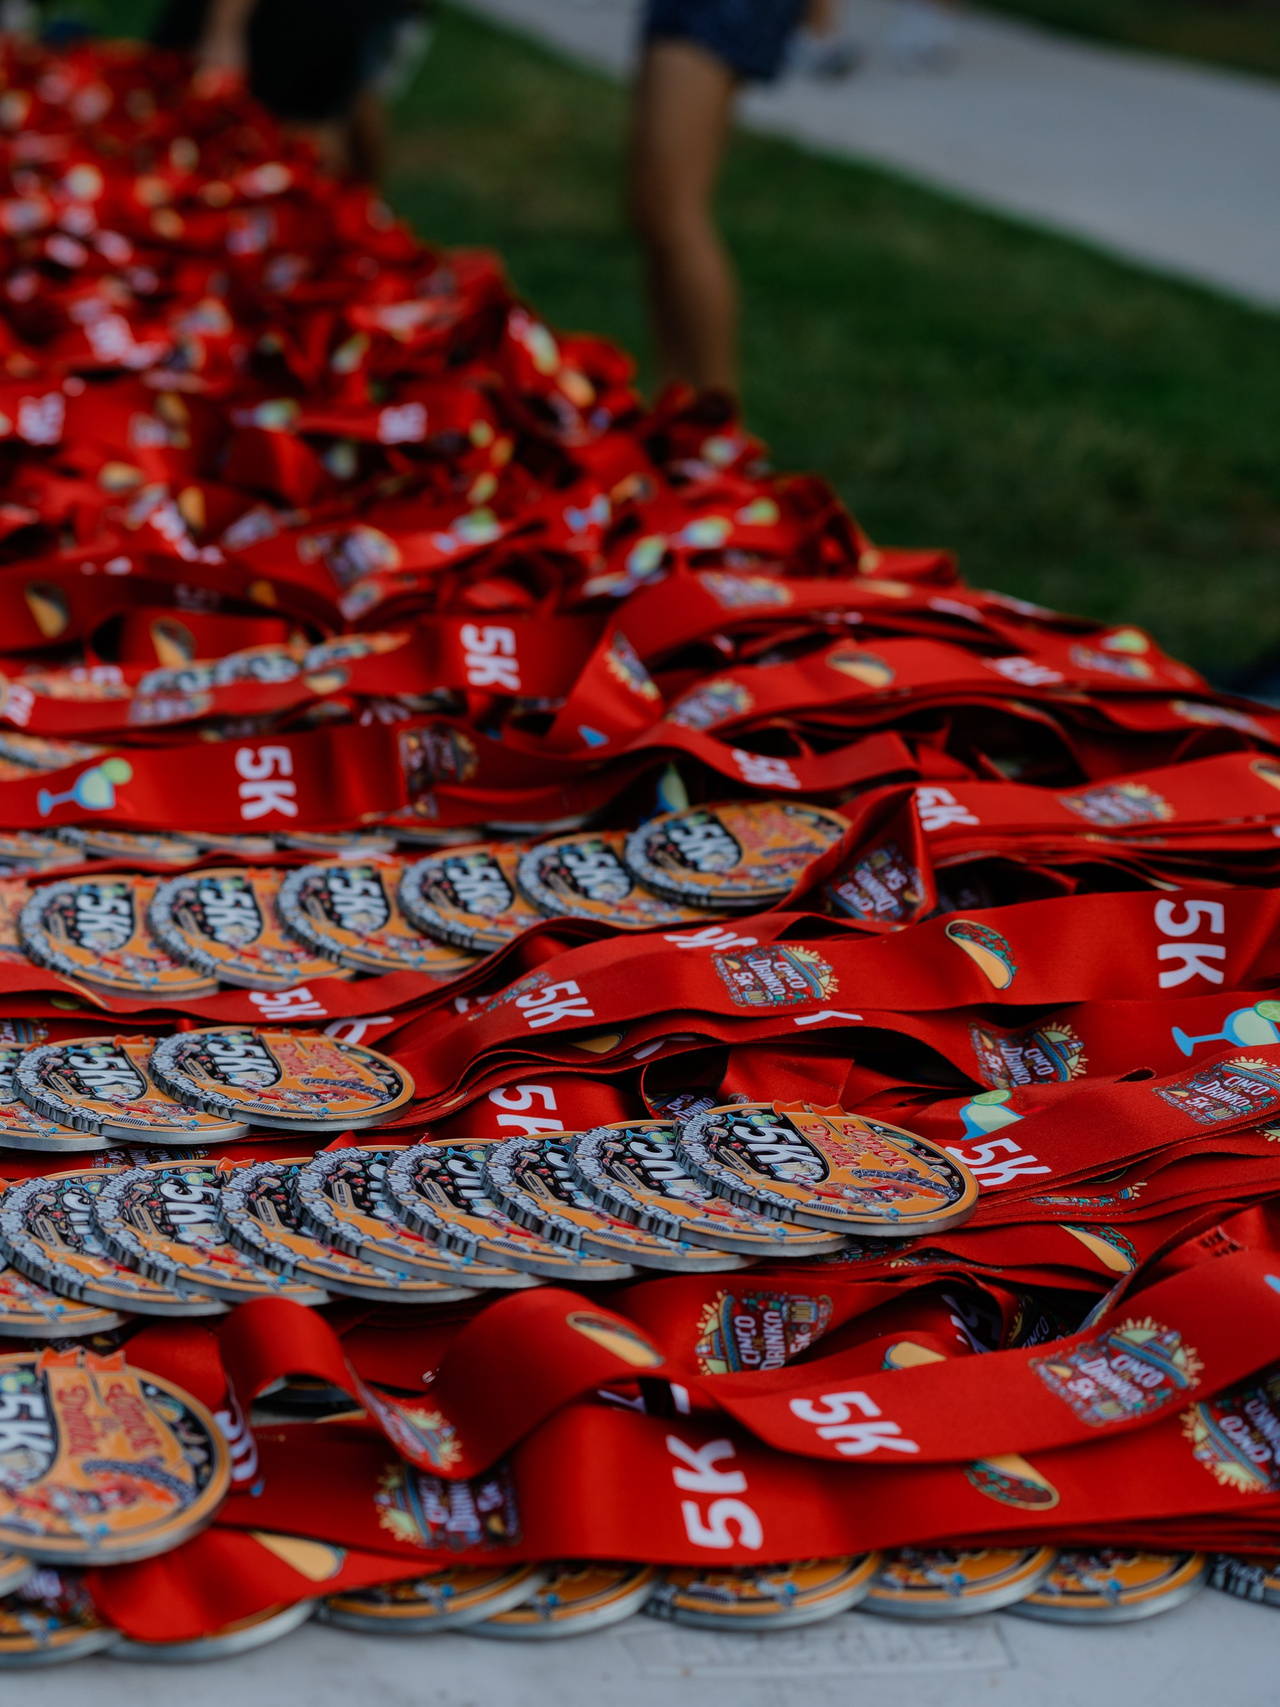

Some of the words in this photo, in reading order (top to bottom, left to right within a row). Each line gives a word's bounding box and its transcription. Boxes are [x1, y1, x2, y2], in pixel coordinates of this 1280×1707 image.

[461, 624, 520, 690] 5K
[235, 746, 298, 820] 5K
[668, 823, 740, 867] 5K
[328, 878, 388, 921] 5K
[447, 866, 512, 908] 5K
[75, 894, 132, 936] 5K
[200, 889, 261, 933] 5K
[1154, 899, 1226, 988] 5K
[733, 971, 754, 986] 5K
[748, 959, 786, 995] DRINKO
[773, 961, 808, 988] CINCO
[249, 986, 327, 1019] 5K
[516, 980, 594, 1029] 5K
[69, 1056, 143, 1088] 5K
[208, 1042, 278, 1073] 5K
[984, 1052, 1002, 1072] 5K
[1000, 1047, 1031, 1084] DRINKO
[1024, 1048, 1055, 1075] CINCO
[1185, 1097, 1211, 1109] 5K
[1195, 1080, 1250, 1107] DRINKO
[1223, 1076, 1270, 1096] CINCO
[733, 1125, 823, 1166] 5K
[801, 1122, 861, 1169] Drinko
[842, 1122, 909, 1167] Cinco
[944, 1137, 1052, 1187] 5K
[734, 1315, 761, 1364] CINCO
[789, 1391, 919, 1457] 5K
[666, 1435, 763, 1550] 5K
